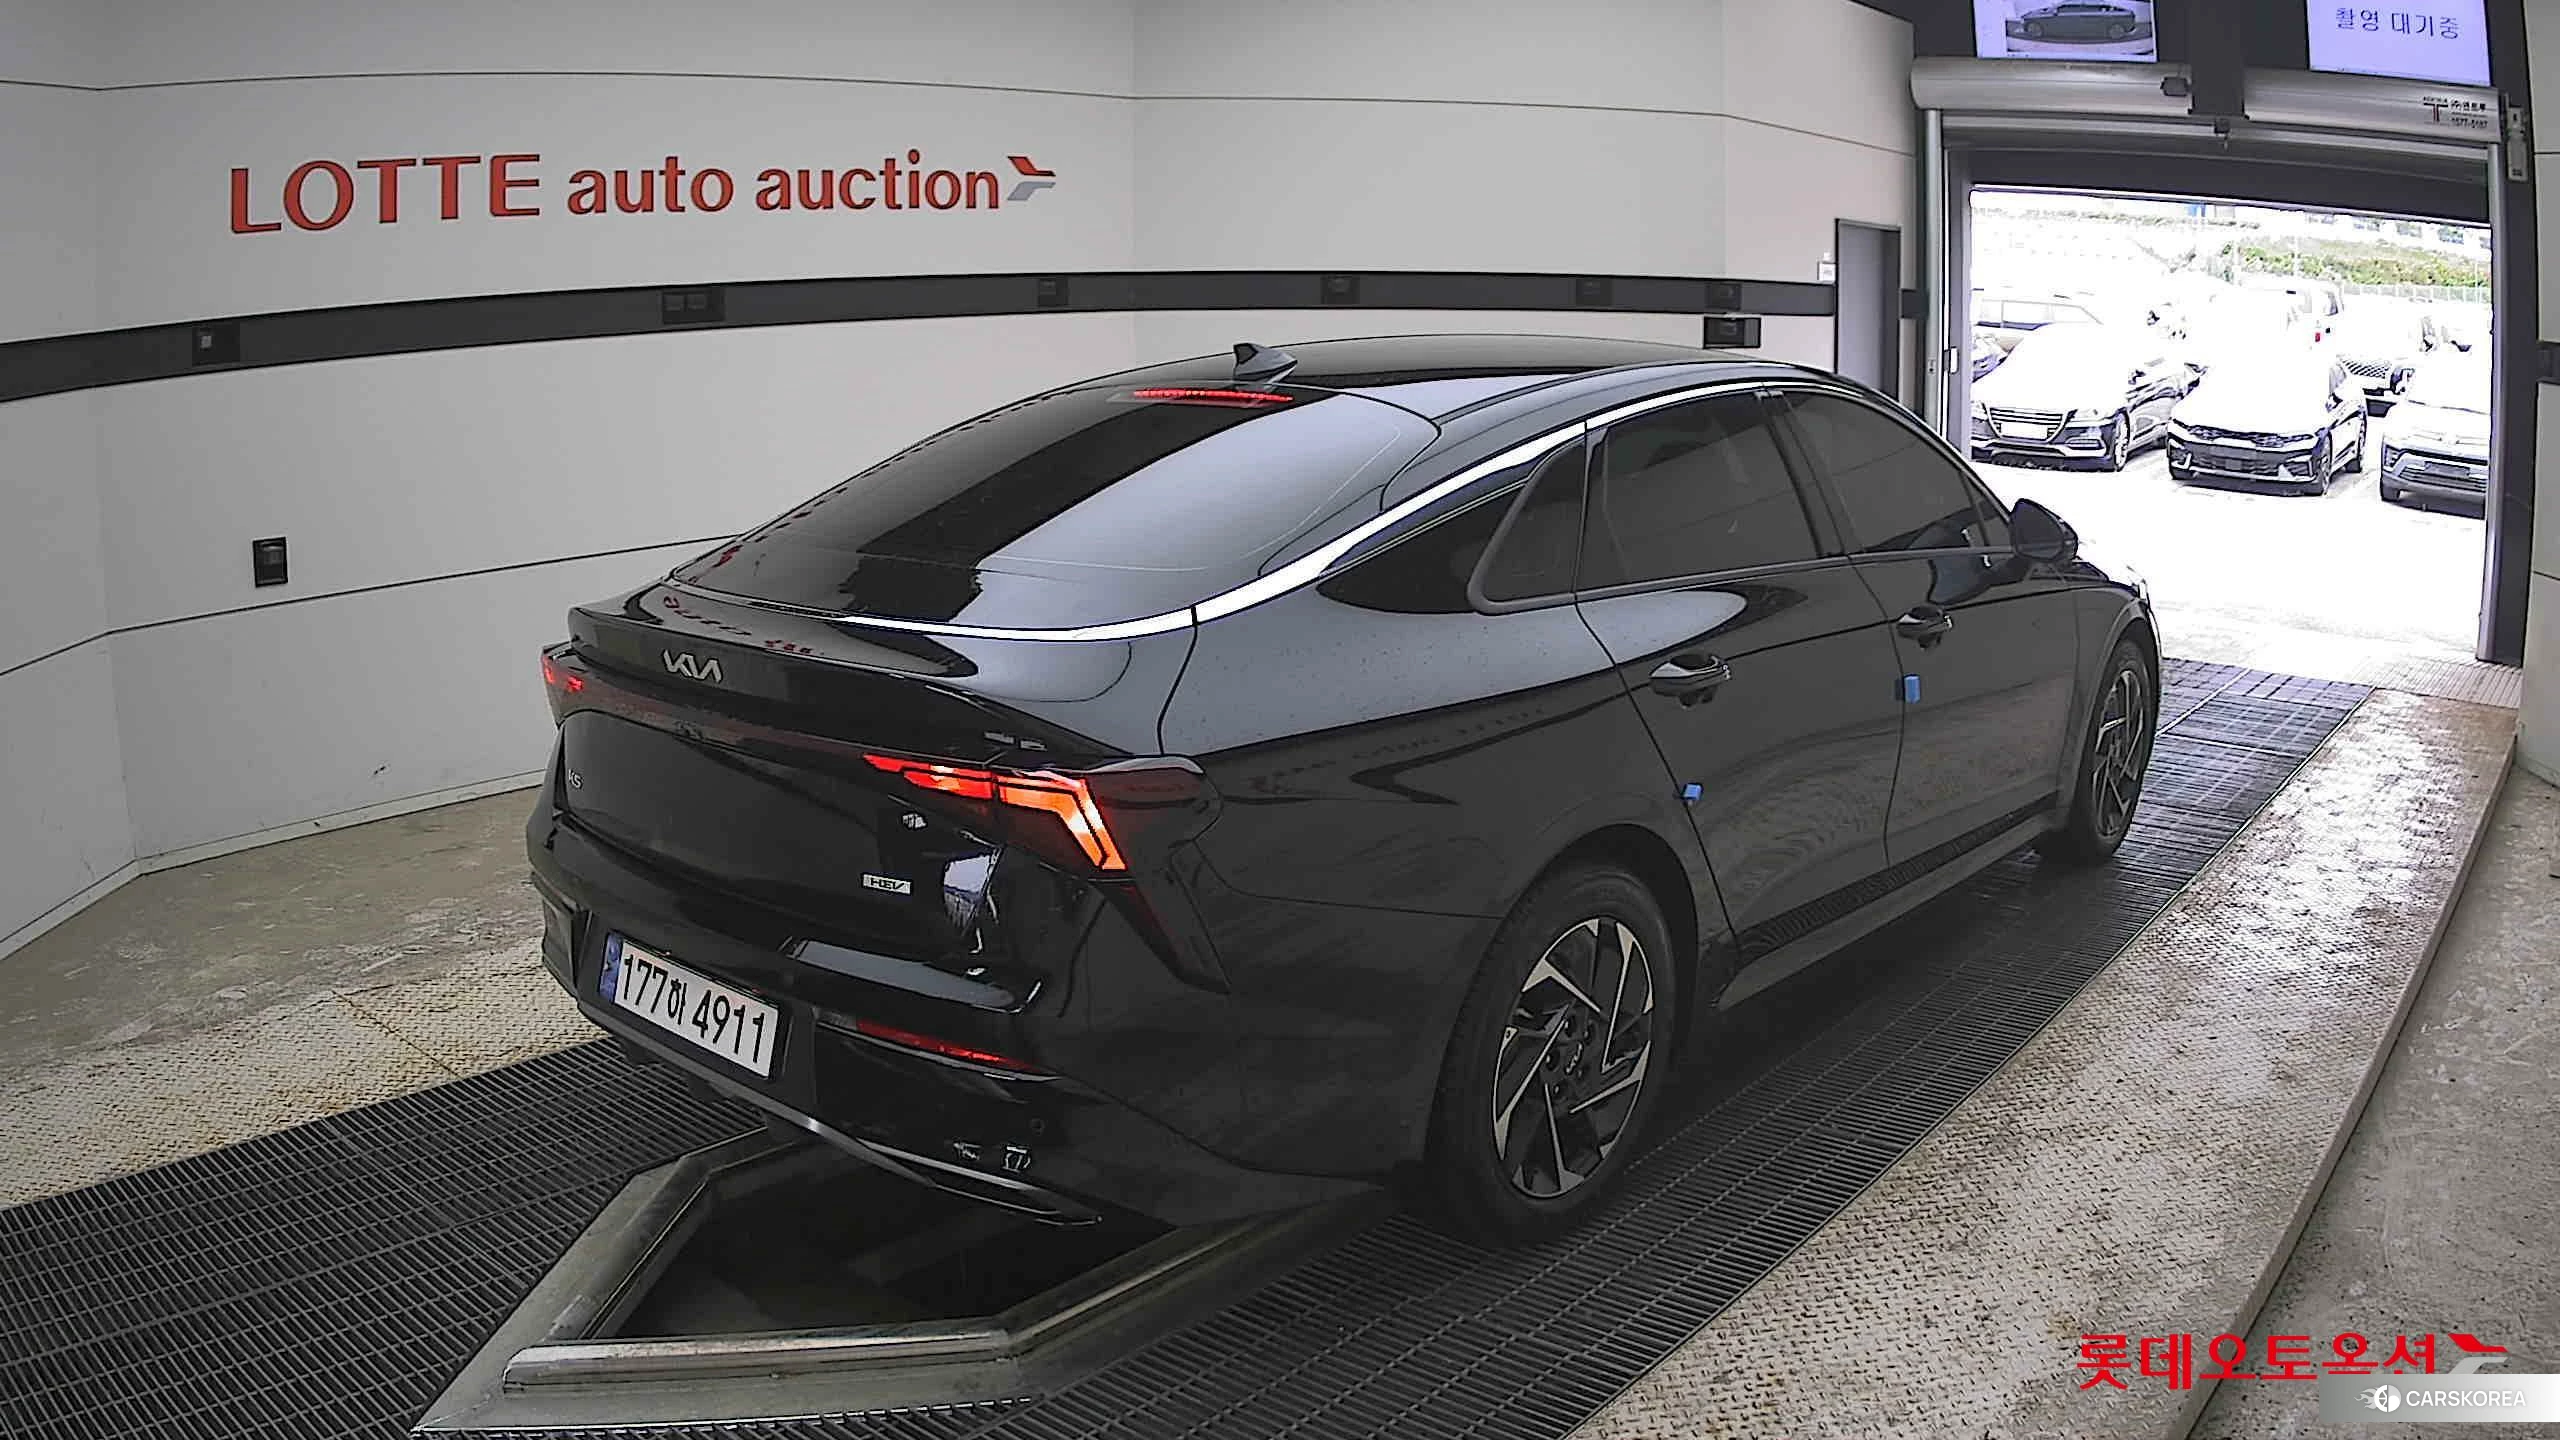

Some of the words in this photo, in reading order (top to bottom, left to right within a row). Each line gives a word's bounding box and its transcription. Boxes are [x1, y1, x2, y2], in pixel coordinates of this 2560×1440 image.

[2336, 7, 2380, 32] 촬영
[2391, 12, 2459, 40] 대기중
[231, 153, 540, 234] LOTTE
[567, 156, 734, 215] auto
[755, 149, 1000, 210] auction
[661, 649, 723, 684] KIA
[623, 953, 689, 1026] 177하
[691, 989, 765, 1064] 4911
